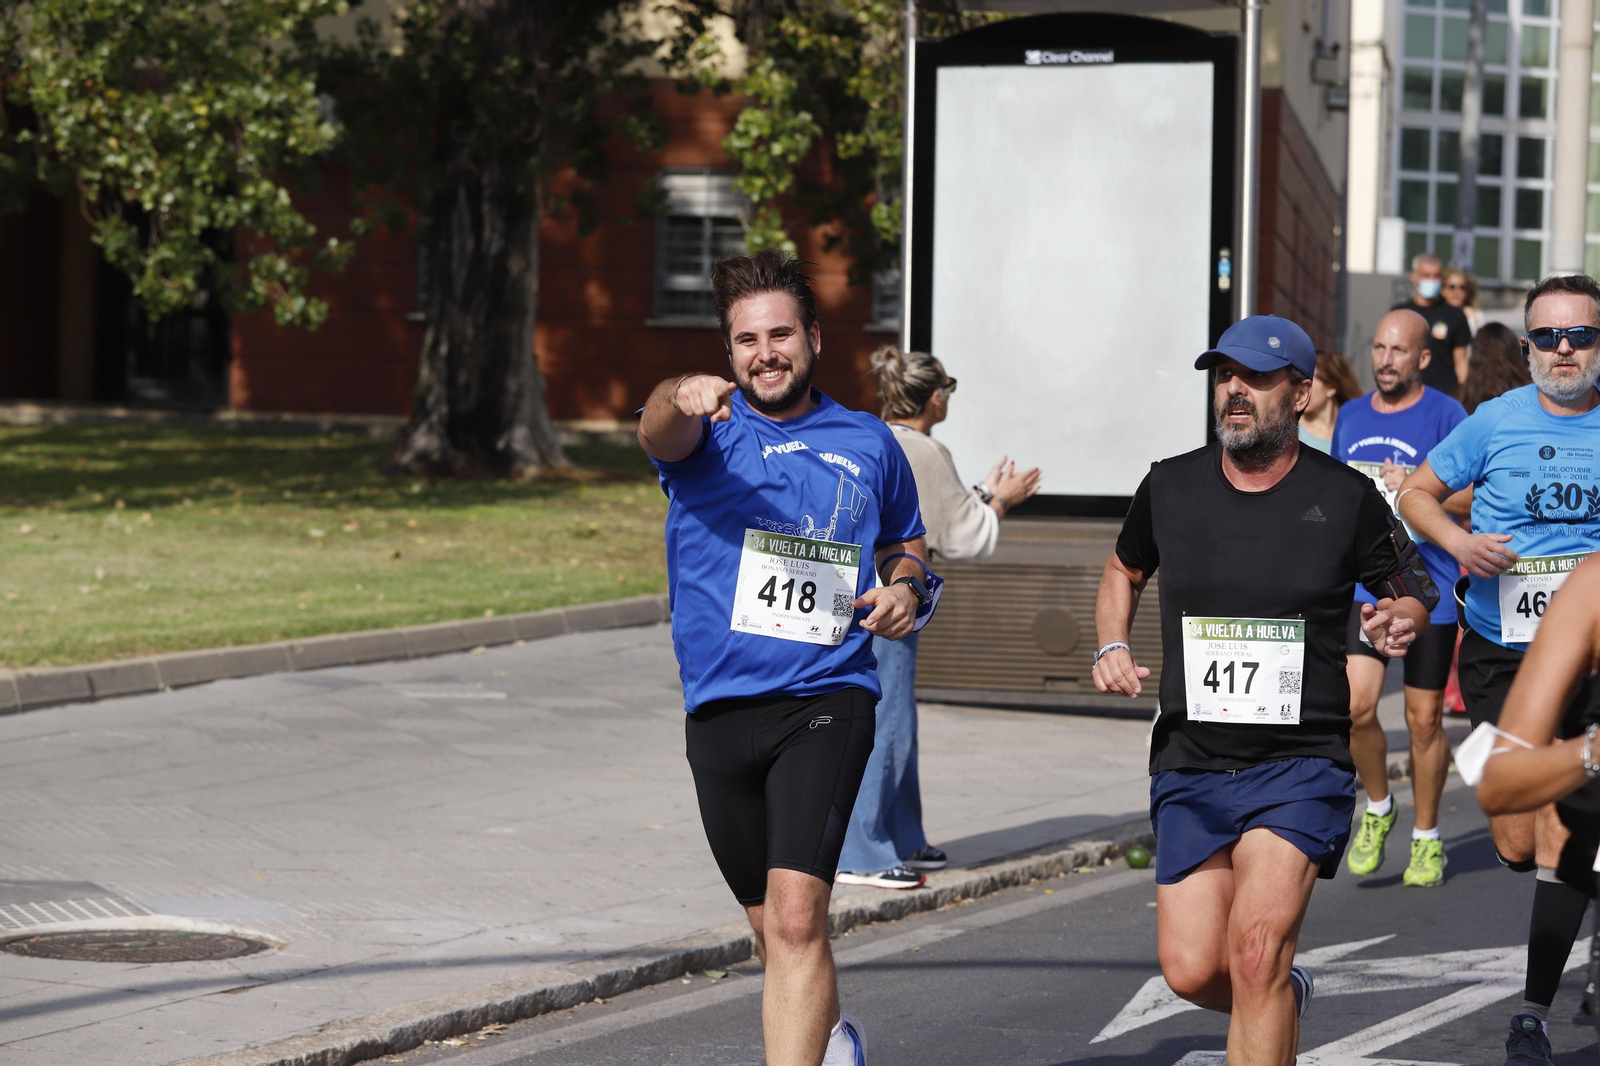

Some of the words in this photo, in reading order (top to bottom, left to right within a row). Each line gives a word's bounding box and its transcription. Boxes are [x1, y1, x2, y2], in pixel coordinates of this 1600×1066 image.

[1041, 51, 1069, 63] Clear
[1070, 50, 1114, 63] Channel
[1545, 482, 1582, 511] 30
[1554, 525, 1566, 536] A
[752, 537, 766, 550] 34
[769, 538, 806, 557] VUELTA
[809, 545, 816, 558] A
[818, 546, 852, 563] HUELVA
[768, 557, 789, 566] JOSE
[790, 560, 810, 569] LUIS
[1516, 561, 1547, 573] VUELTA
[1549, 560, 1557, 572] A
[788, 568, 817, 577] SERRANO
[757, 575, 817, 614] 418
[1516, 590, 1559, 618] 46
[772, 612, 811, 622] INDEPENDIENTE
[1192, 623, 1203, 637] 34
[1205, 623, 1243, 638] VUELTA
[1245, 624, 1254, 638] A
[1256, 624, 1296, 640] HUELVA
[1207, 642, 1227, 650] JOSE
[1203, 660, 1260, 694] 417
